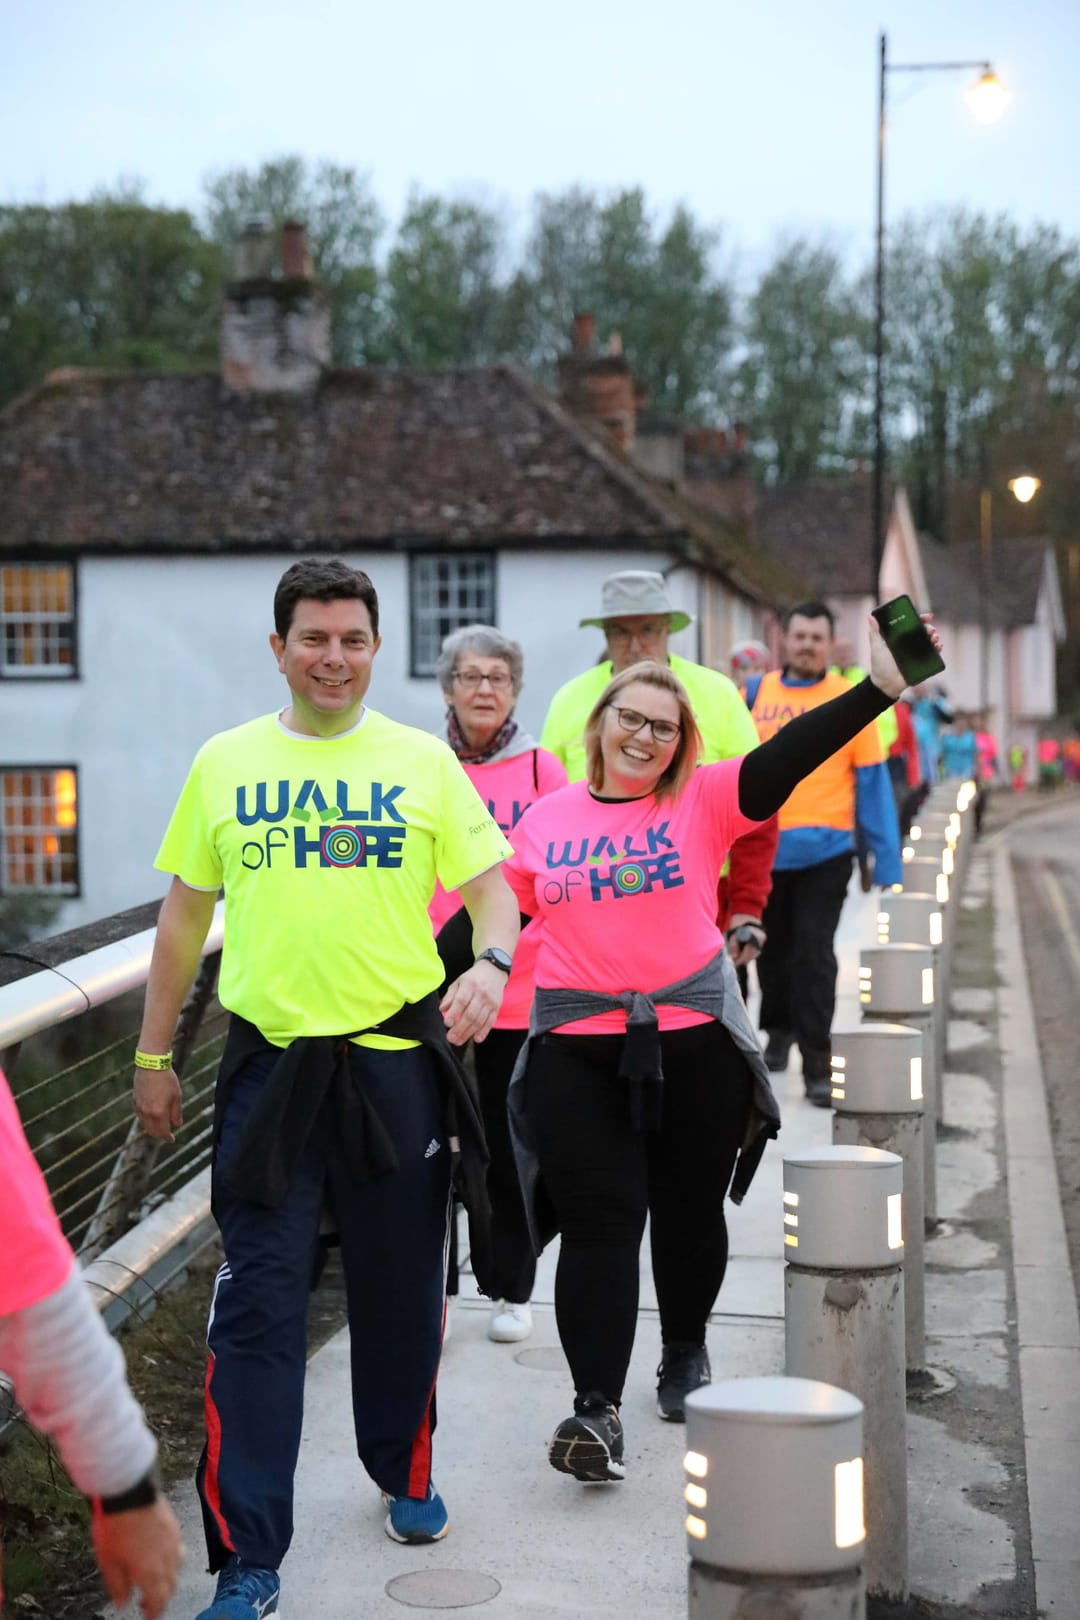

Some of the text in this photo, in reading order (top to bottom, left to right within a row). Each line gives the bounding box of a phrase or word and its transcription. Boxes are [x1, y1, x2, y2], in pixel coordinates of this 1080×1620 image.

[236, 779, 407, 826] WALK
[294, 824, 406, 868] HOPE
[546, 821, 675, 868] WALK
[589, 852, 685, 902] HOPE
